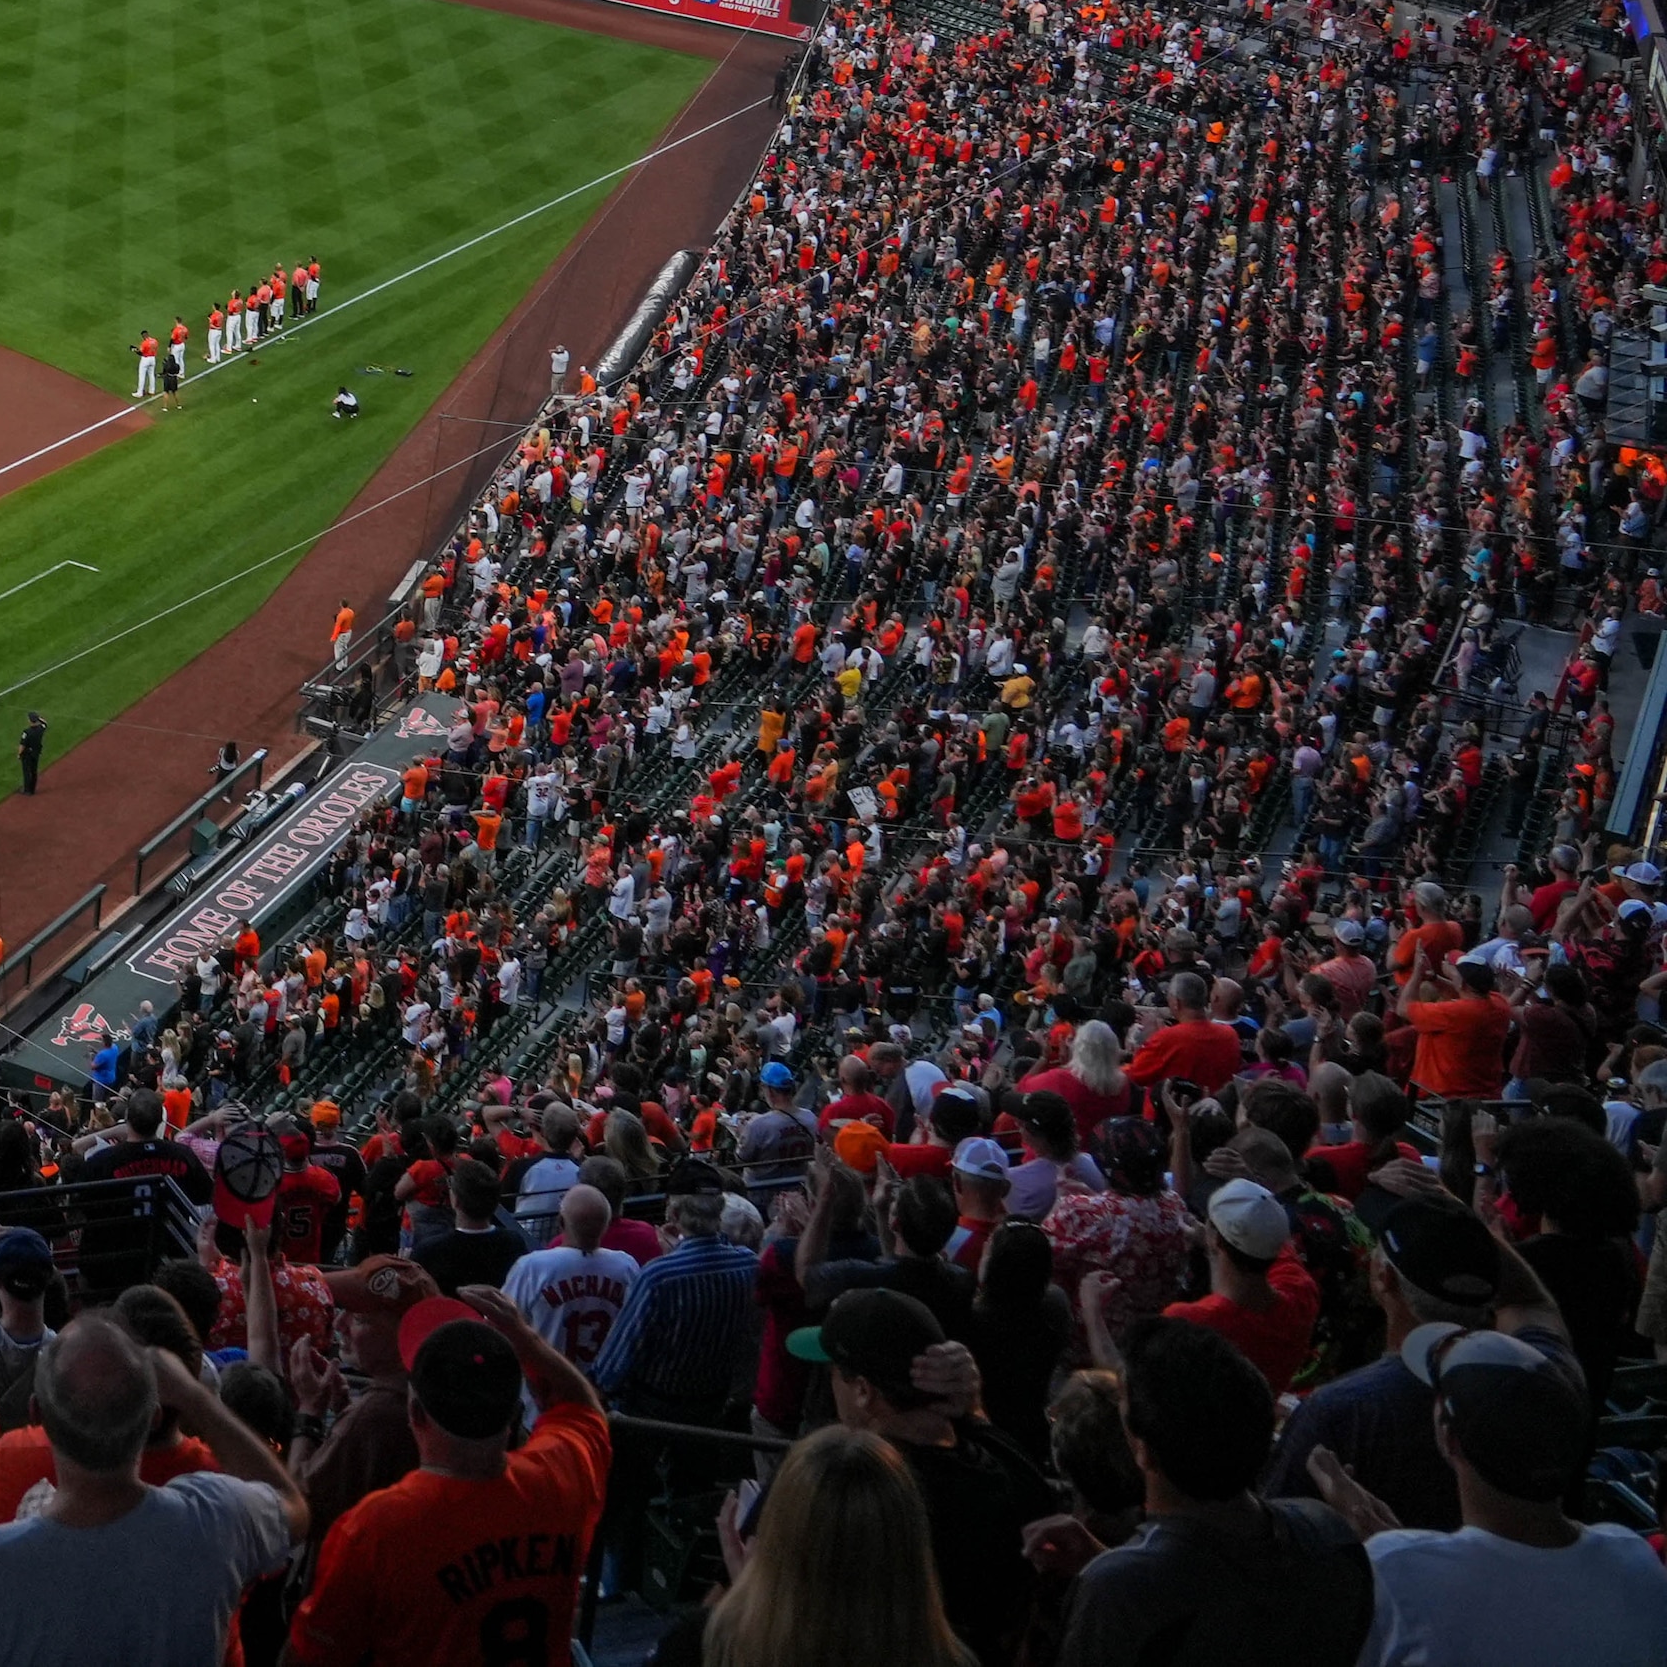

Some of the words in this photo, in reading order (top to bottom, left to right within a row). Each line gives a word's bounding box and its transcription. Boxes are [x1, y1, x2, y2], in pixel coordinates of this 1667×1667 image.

[718, 1, 748, 13] MOTOR
[749, 5, 779, 18] FUELS
[145, 907, 238, 972] HOME
[216, 879, 265, 911] OF
[243, 842, 310, 884] THE
[288, 770, 388, 846] ORIOLES
[564, 1309, 613, 1363] 13
[437, 1533, 579, 1605] RIPKEN
